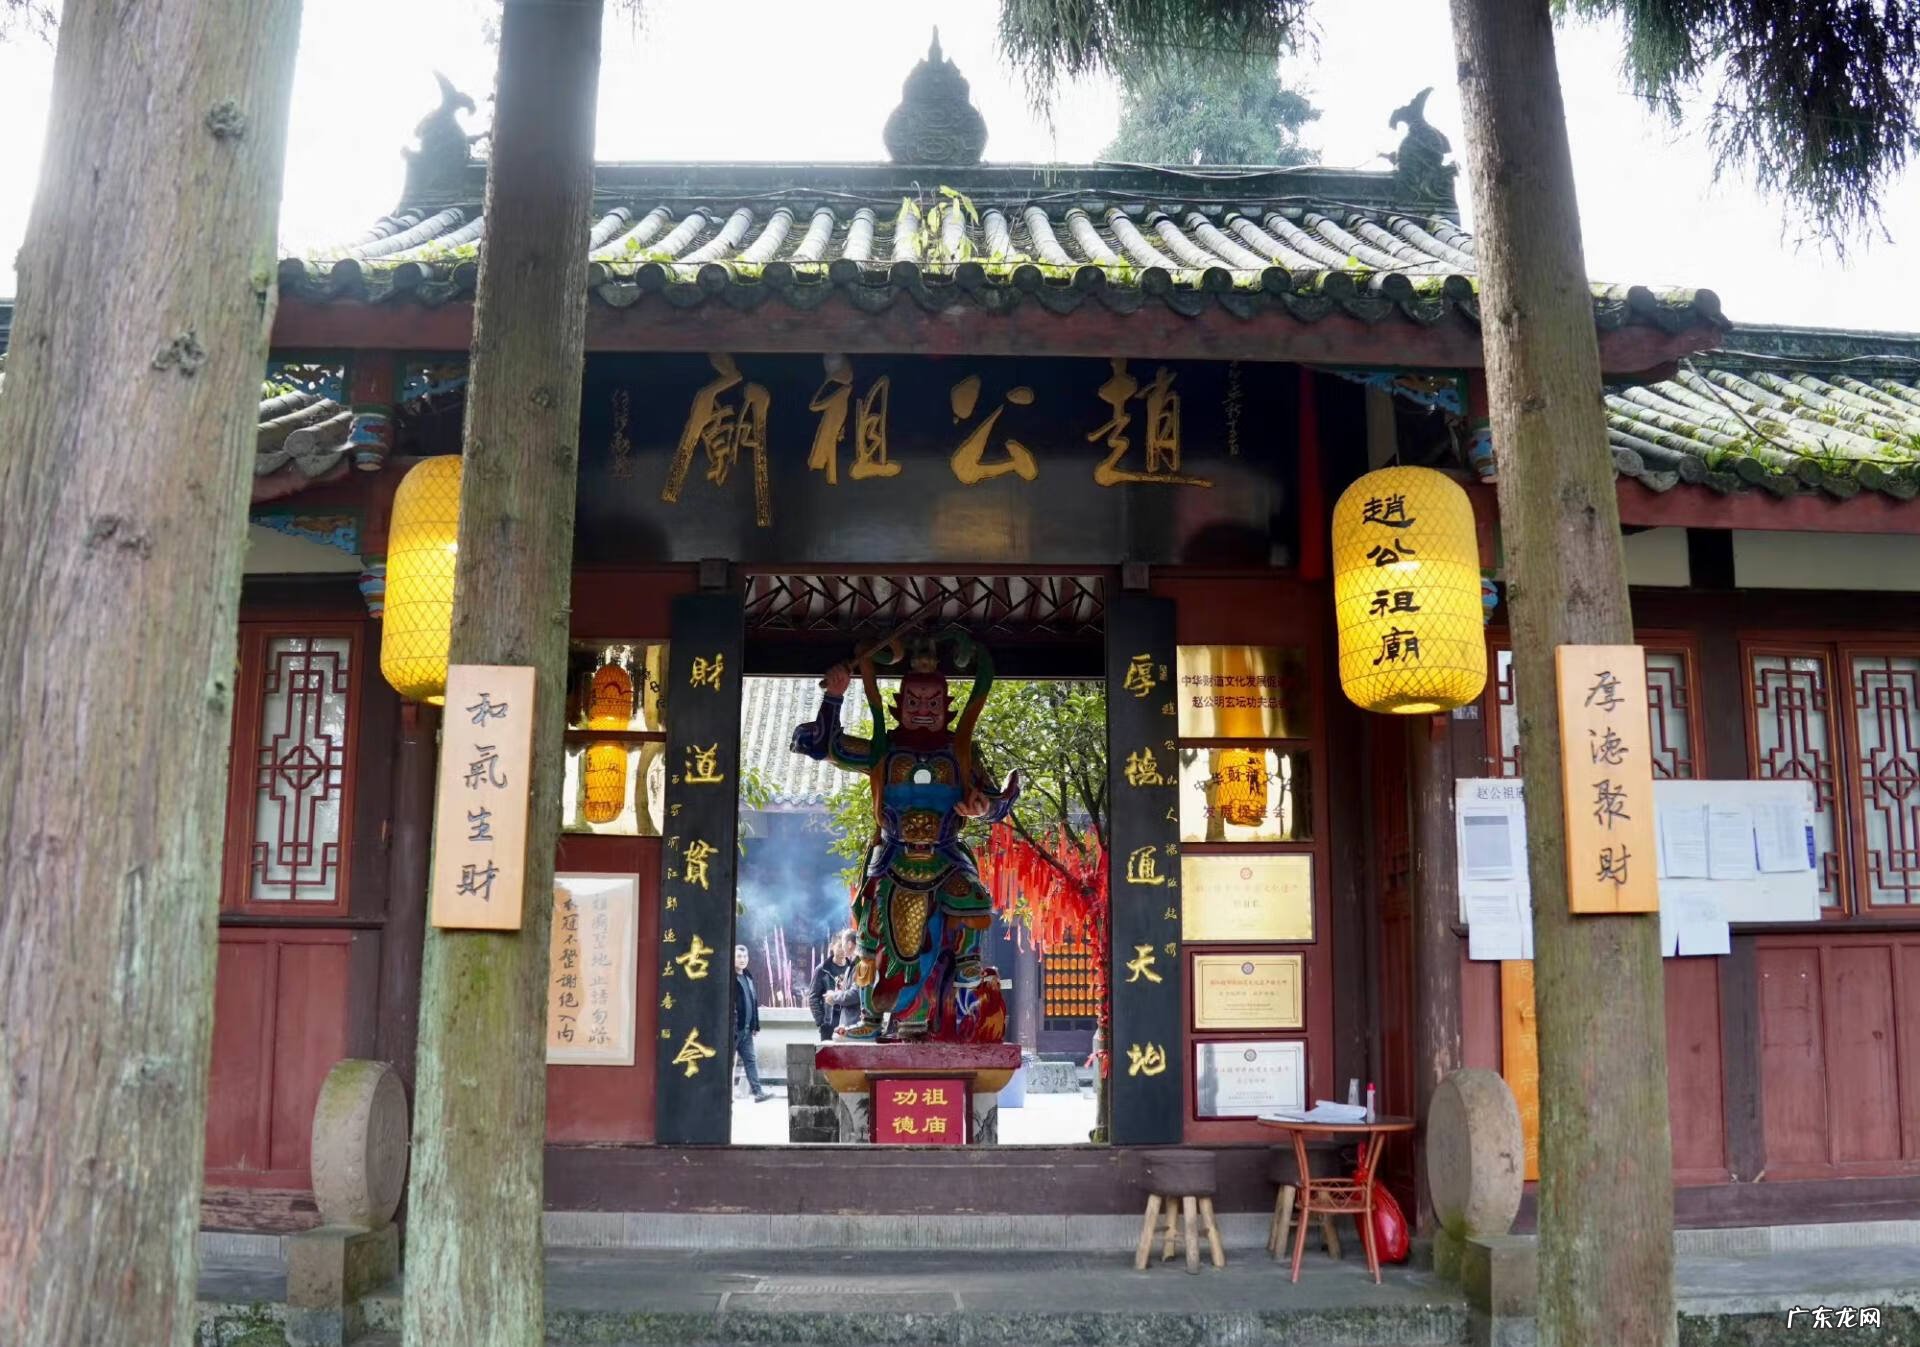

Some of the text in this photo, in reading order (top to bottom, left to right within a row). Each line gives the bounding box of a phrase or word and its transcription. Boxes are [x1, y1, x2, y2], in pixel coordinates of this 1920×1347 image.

[660, 352, 1215, 528] 趙公祖廟
[1362, 494, 1422, 666] 趙公祖廟
[455, 692, 509, 903] 和氣生財
[1122, 652, 1167, 1078] 厚德通天地
[1583, 669, 1632, 886] 厚德聚財
